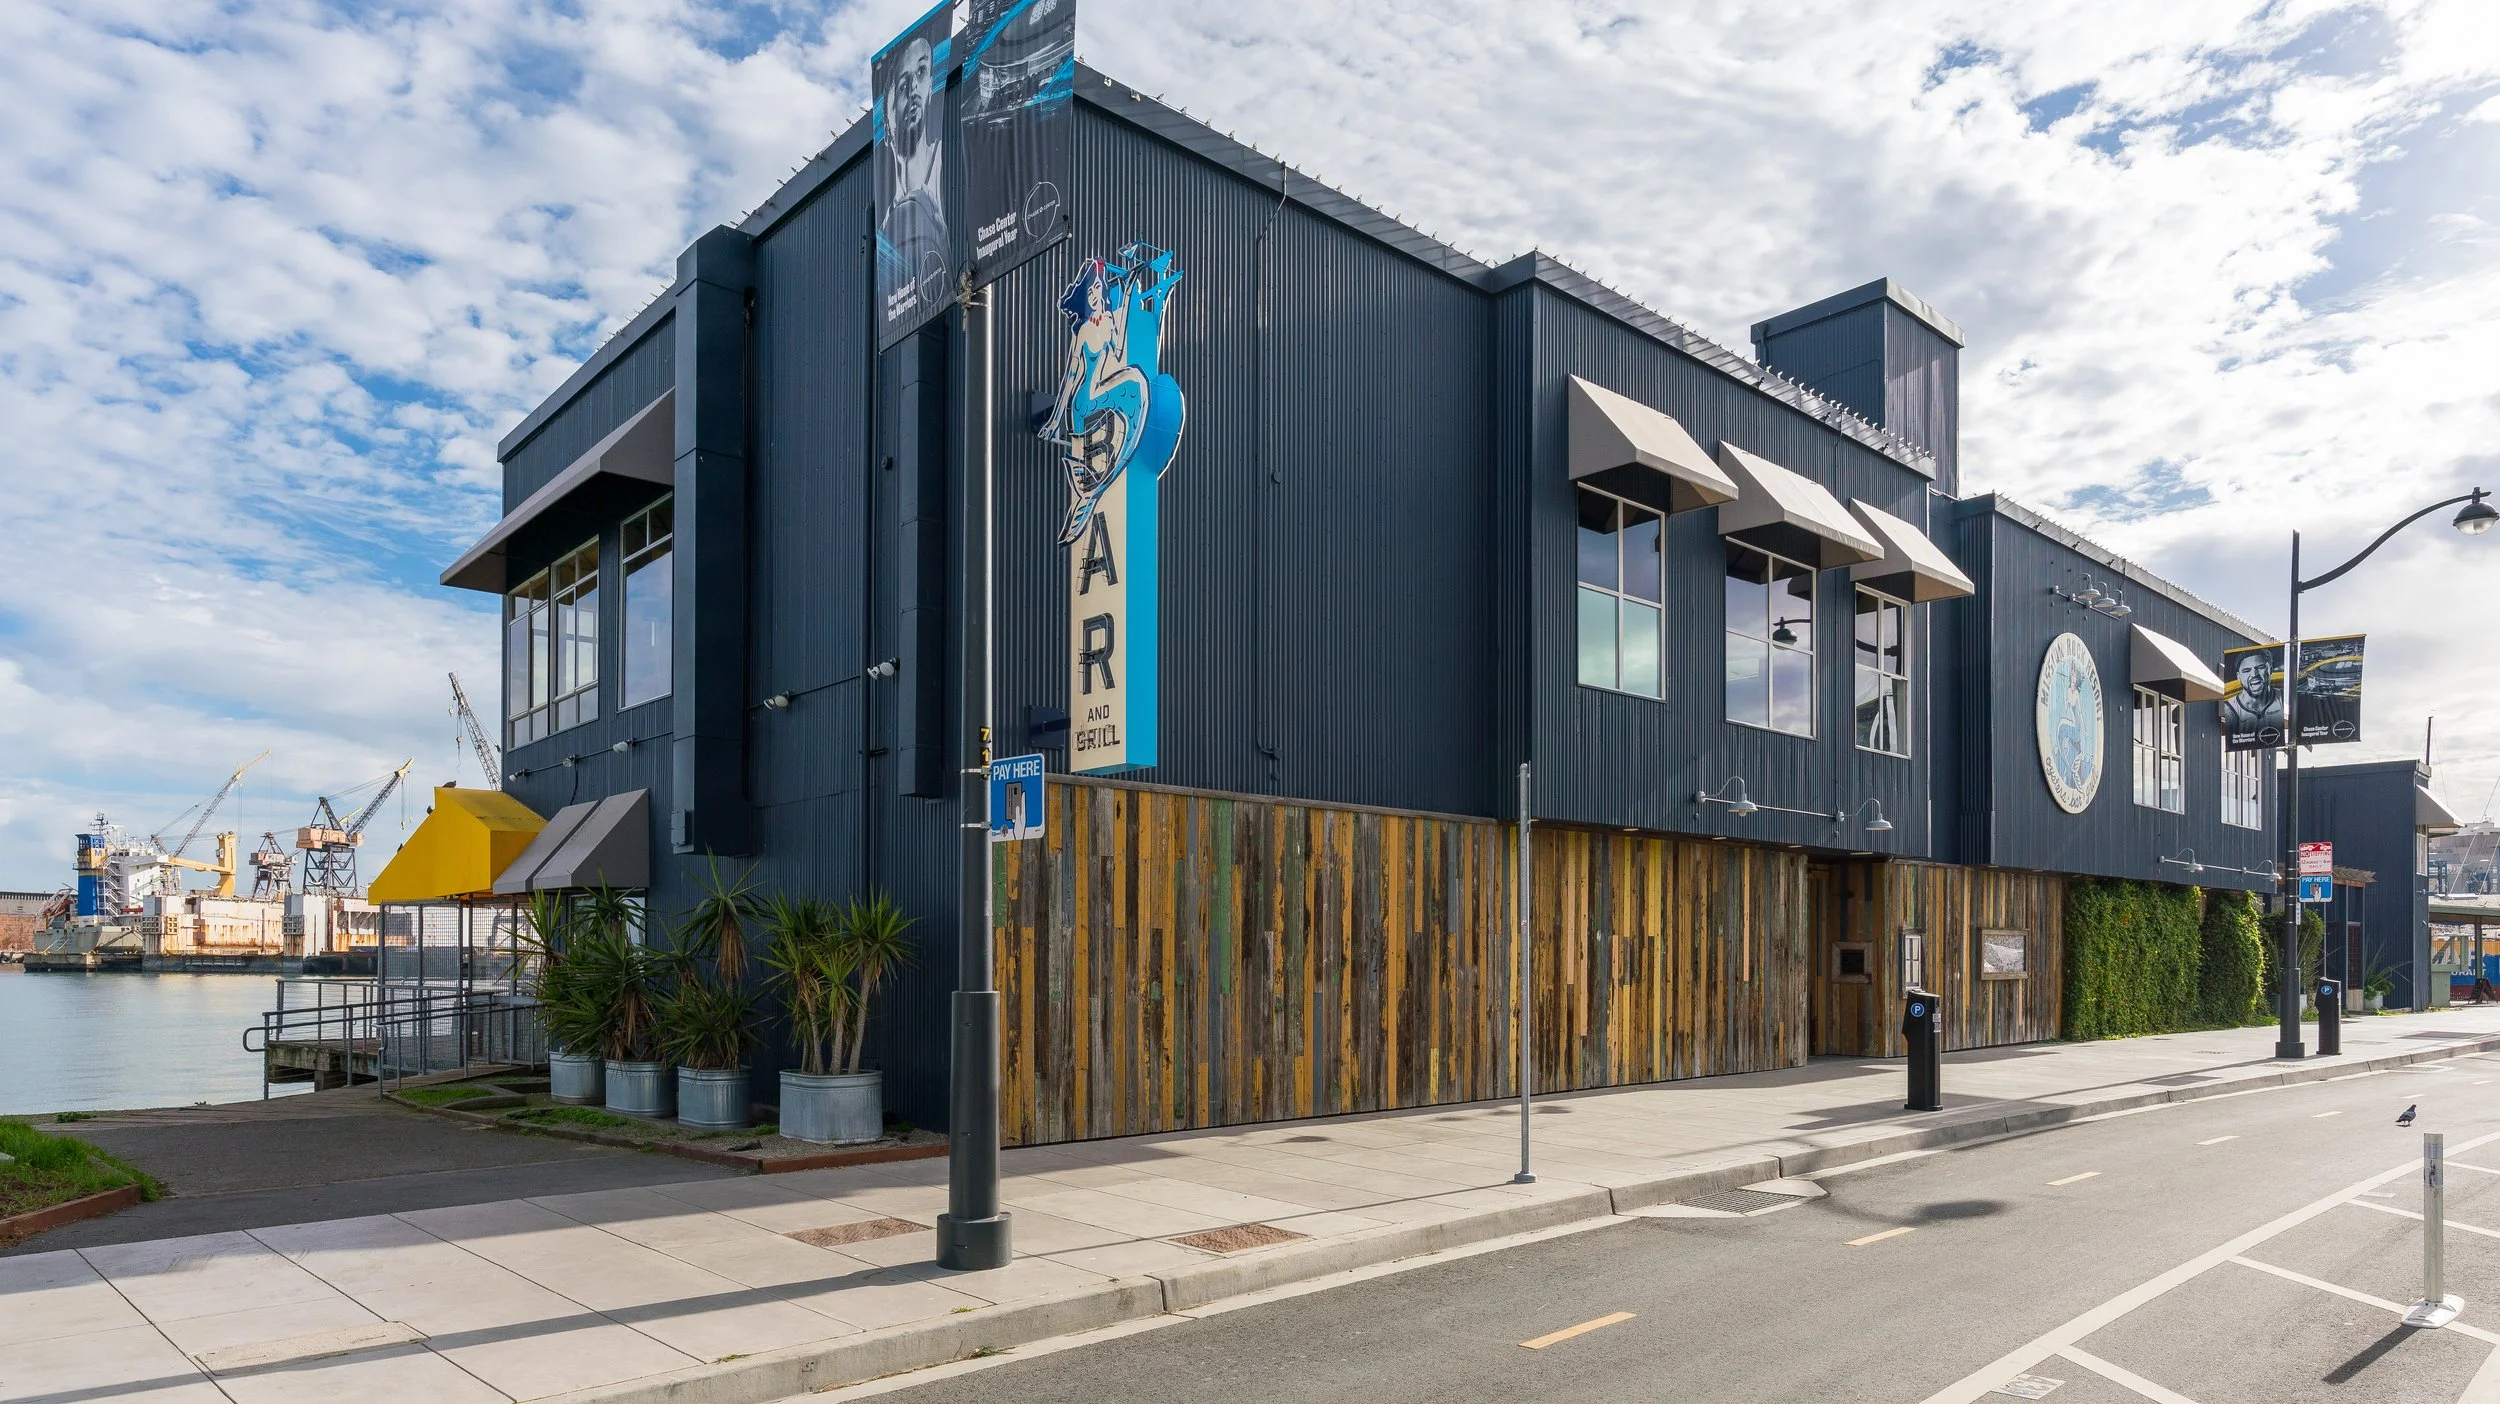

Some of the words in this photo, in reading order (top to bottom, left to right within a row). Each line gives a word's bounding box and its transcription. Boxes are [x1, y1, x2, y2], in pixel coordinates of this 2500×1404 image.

[978, 223, 996, 242] Chase
[996, 212, 1017, 231] Center
[1027, 210, 1039, 220] CHASE
[977, 233, 1004, 260] Inaugural
[1004, 228, 1018, 244] Year
[897, 284, 910, 300] Home
[910, 277, 915, 291] of
[888, 309, 896, 322] the
[896, 295, 917, 316] Warriors
[1079, 407, 1119, 695] BAR
[2041, 642, 2064, 707] MISSION
[2067, 638, 2085, 665] ROCK
[2086, 659, 2102, 722] RESORT
[1087, 705, 1110, 722] AND
[1074, 725, 1120, 751] GRILL
[993, 764, 1011, 781] PAY
[1013, 760, 1040, 779] HERE
